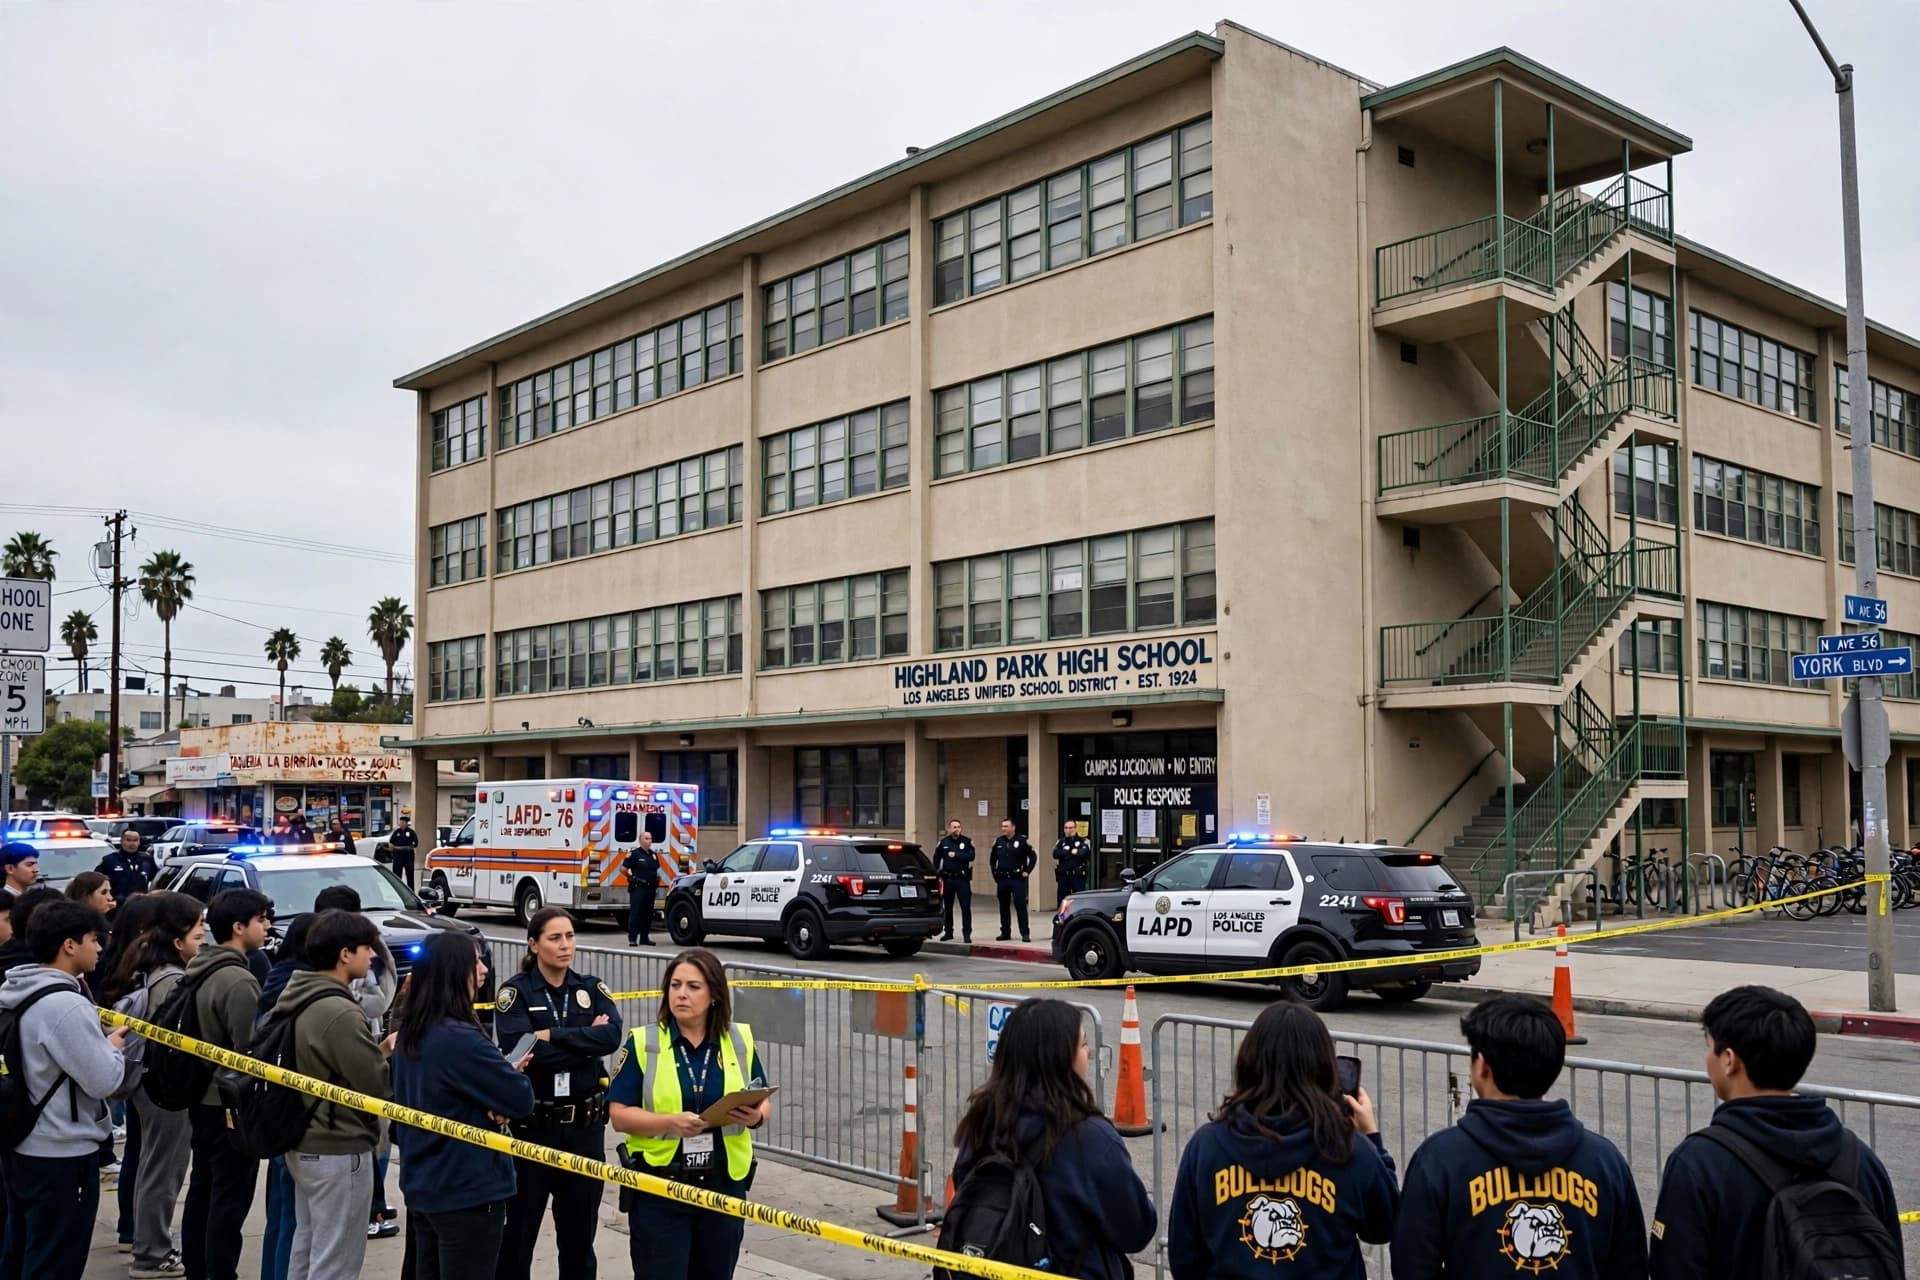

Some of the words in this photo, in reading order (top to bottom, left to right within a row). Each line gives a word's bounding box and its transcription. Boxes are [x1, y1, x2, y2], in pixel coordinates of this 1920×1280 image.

[0, 588, 46, 607] HOOL
[1848, 600, 1854, 615] N
[1874, 603, 1886, 620] 56
[1821, 640, 1829, 651] N
[1837, 638, 1855, 650] AVE
[1861, 635, 1878, 648] 56
[895, 659, 988, 689] HIGHLAND
[996, 653, 1048, 681] PARK
[1057, 647, 1108, 676] HIGH
[1117, 638, 1213, 671] SCHOOL
[1799, 656, 1844, 675] YORK
[1853, 659, 1884, 671] BLVD
[903, 691, 921, 705] LOS
[926, 688, 970, 703] ANGELES
[975, 684, 1015, 700] UNIFIED
[1020, 680, 1063, 697] SCHOOL
[1069, 676, 1118, 693] DISTRICT
[1138, 673, 1162, 688] EST.
[1168, 670, 1197, 686] 1924
[0, 685, 26, 712] 5
[5, 717, 29, 729] MPH
[268, 756, 280, 768] LA
[325, 757, 357, 769] TACOS
[1085, 759, 1117, 776] CAMPUS
[1120, 758, 1165, 775] LOCKDOWN
[1173, 757, 1186, 775] NO
[1189, 757, 1216, 775] ENTRY
[1114, 788, 1143, 805] POLICE
[1146, 787, 1192, 806] RESPONSE
[708, 892, 740, 907] LAPD
[751, 893, 779, 903] POLICE
[1319, 895, 1357, 908] 2241
[1214, 912, 1227, 920] LOS
[1137, 916, 1192, 937] LAPD
[1213, 920, 1263, 933] POLICE
[382, 1103, 408, 1121] POLICE
[461, 1126, 488, 1145] CROSS
[510, 1140, 542, 1160] POLICE
[543, 1149, 564, 1167] LINE
[570, 1156, 583, 1172] DO
[586, 1160, 605, 1177] NOT
[607, 1166, 639, 1187] CROSS
[686, 1152, 711, 1168] STAFF
[667, 1181, 704, 1205] POLICE
[707, 1191, 731, 1213] LINE
[740, 1200, 754, 1219] DO
[758, 1205, 779, 1226] NOT
[782, 1211, 822, 1236] CROSS
